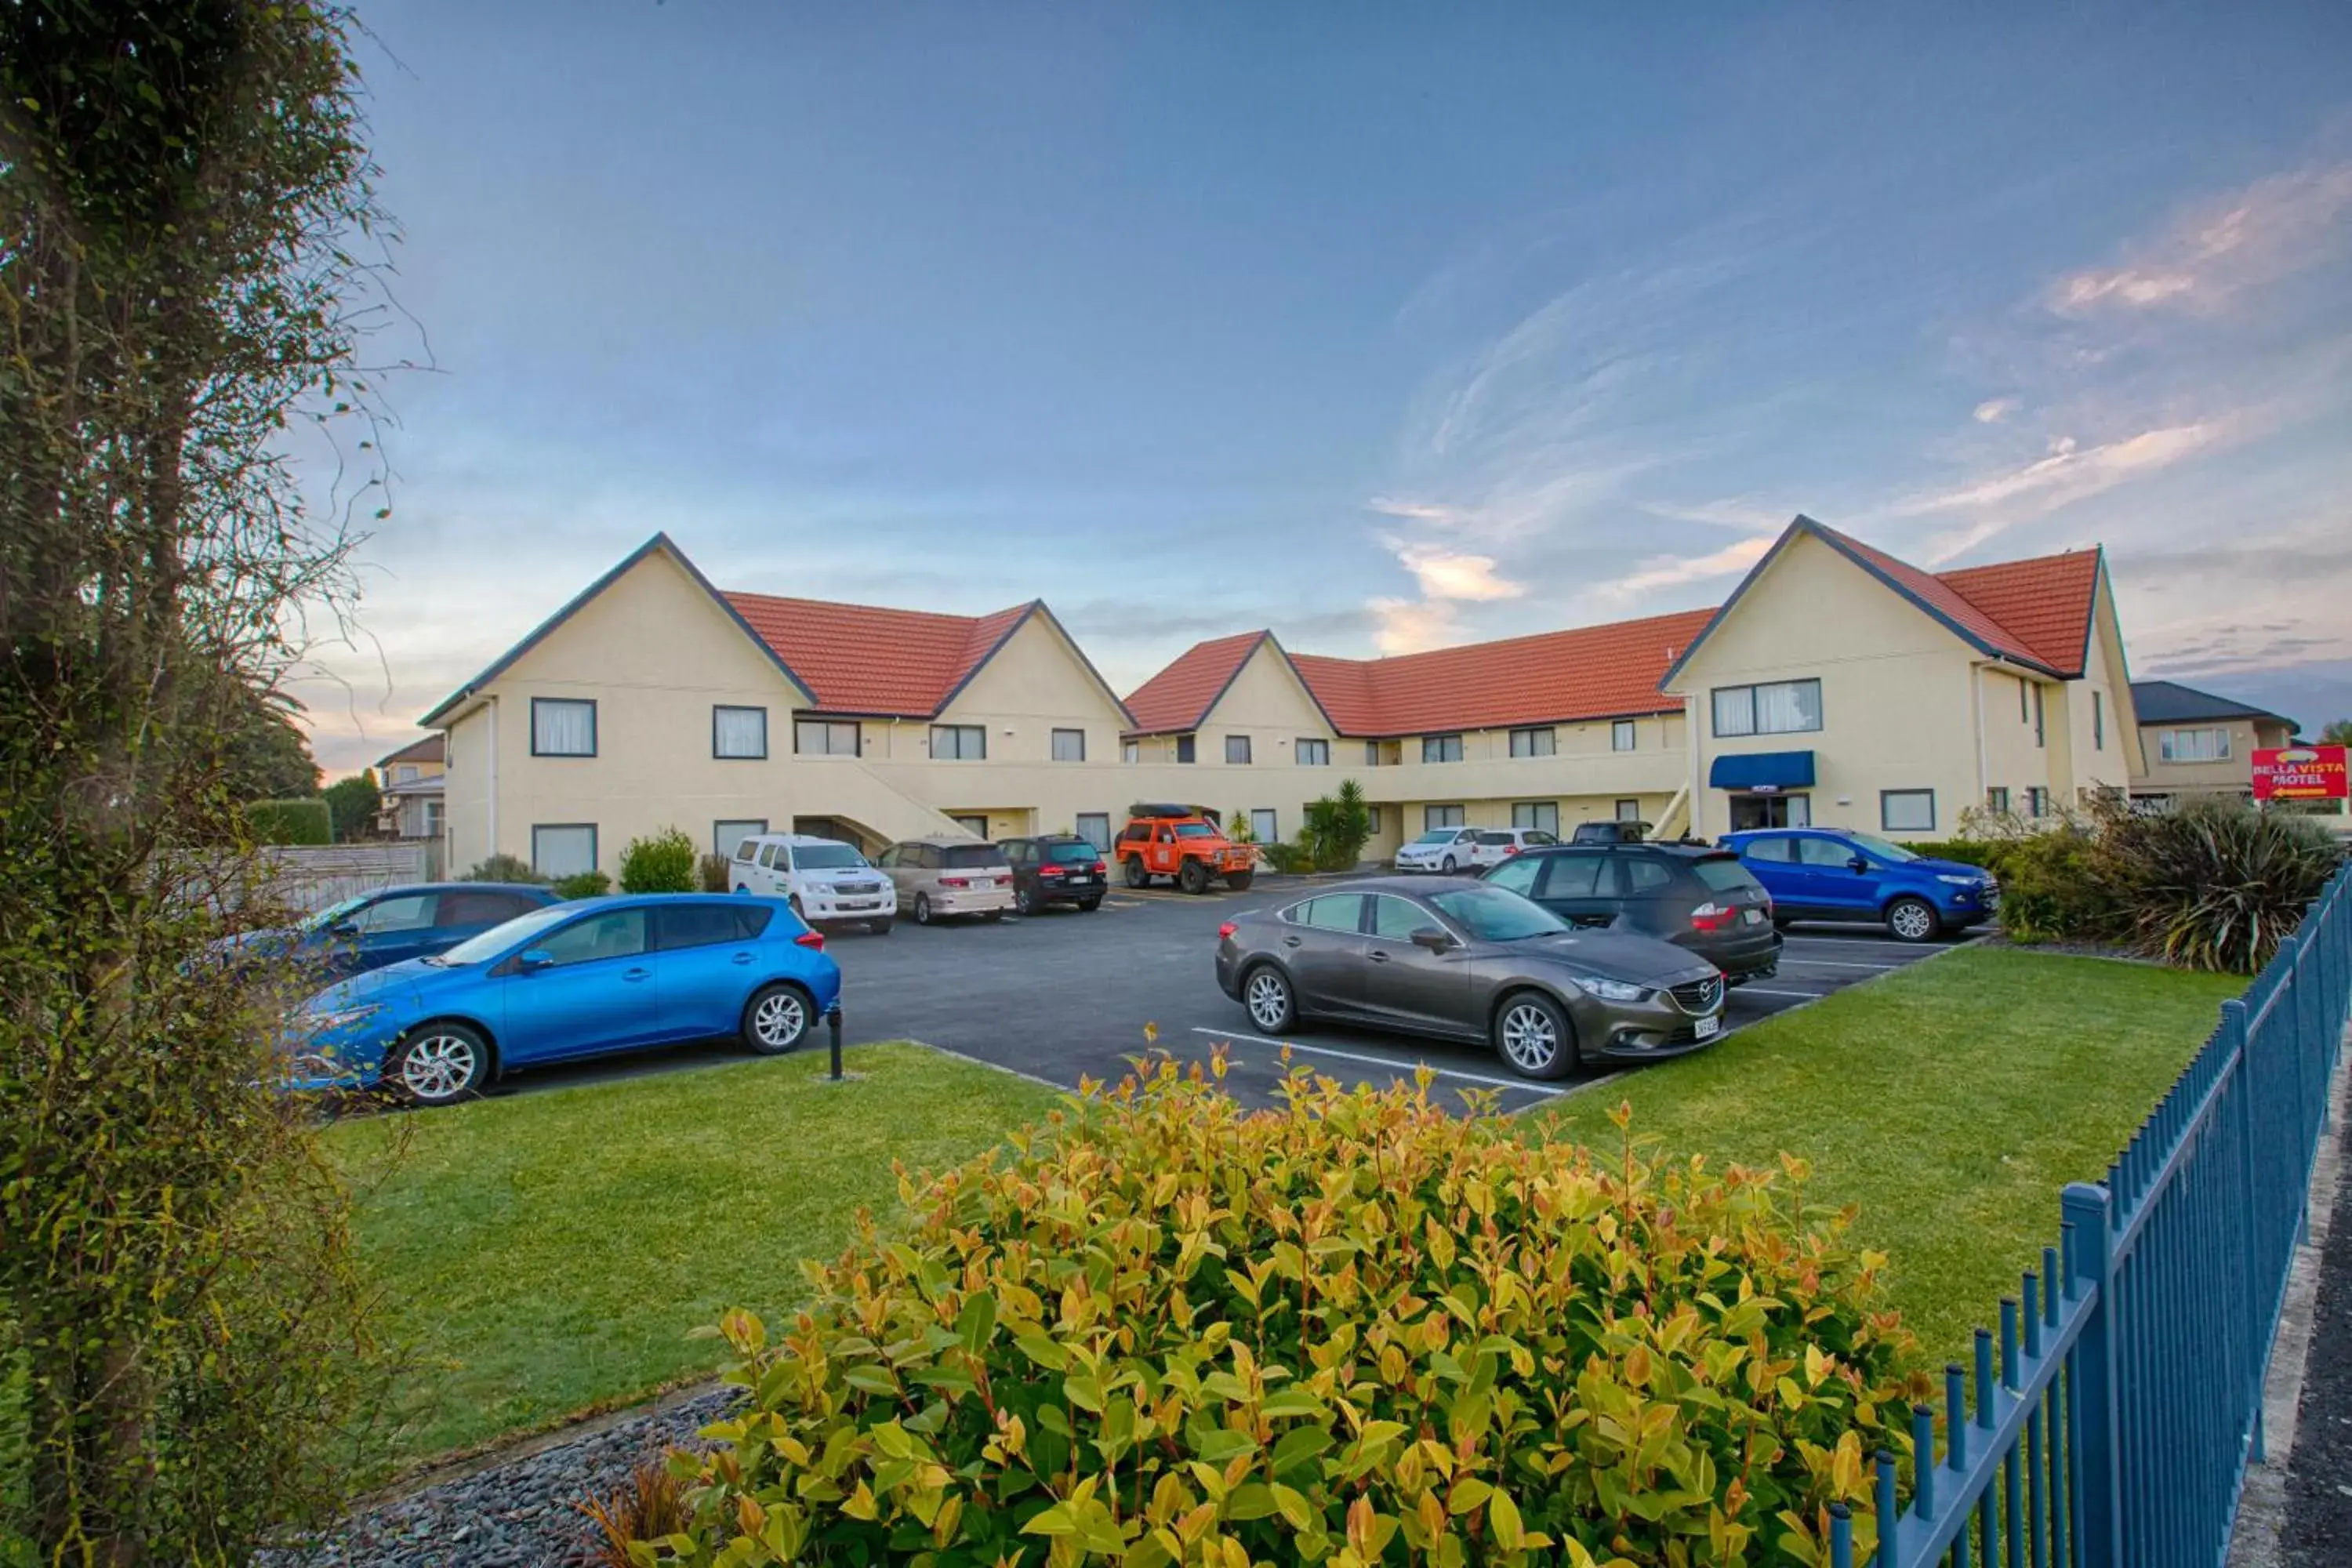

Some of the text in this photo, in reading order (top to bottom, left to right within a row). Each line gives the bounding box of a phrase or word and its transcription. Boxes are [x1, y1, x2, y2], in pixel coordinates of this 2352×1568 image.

[2253, 763, 2345, 775] BELLA VISTA
[2273, 774, 2325, 785] MOTEL
